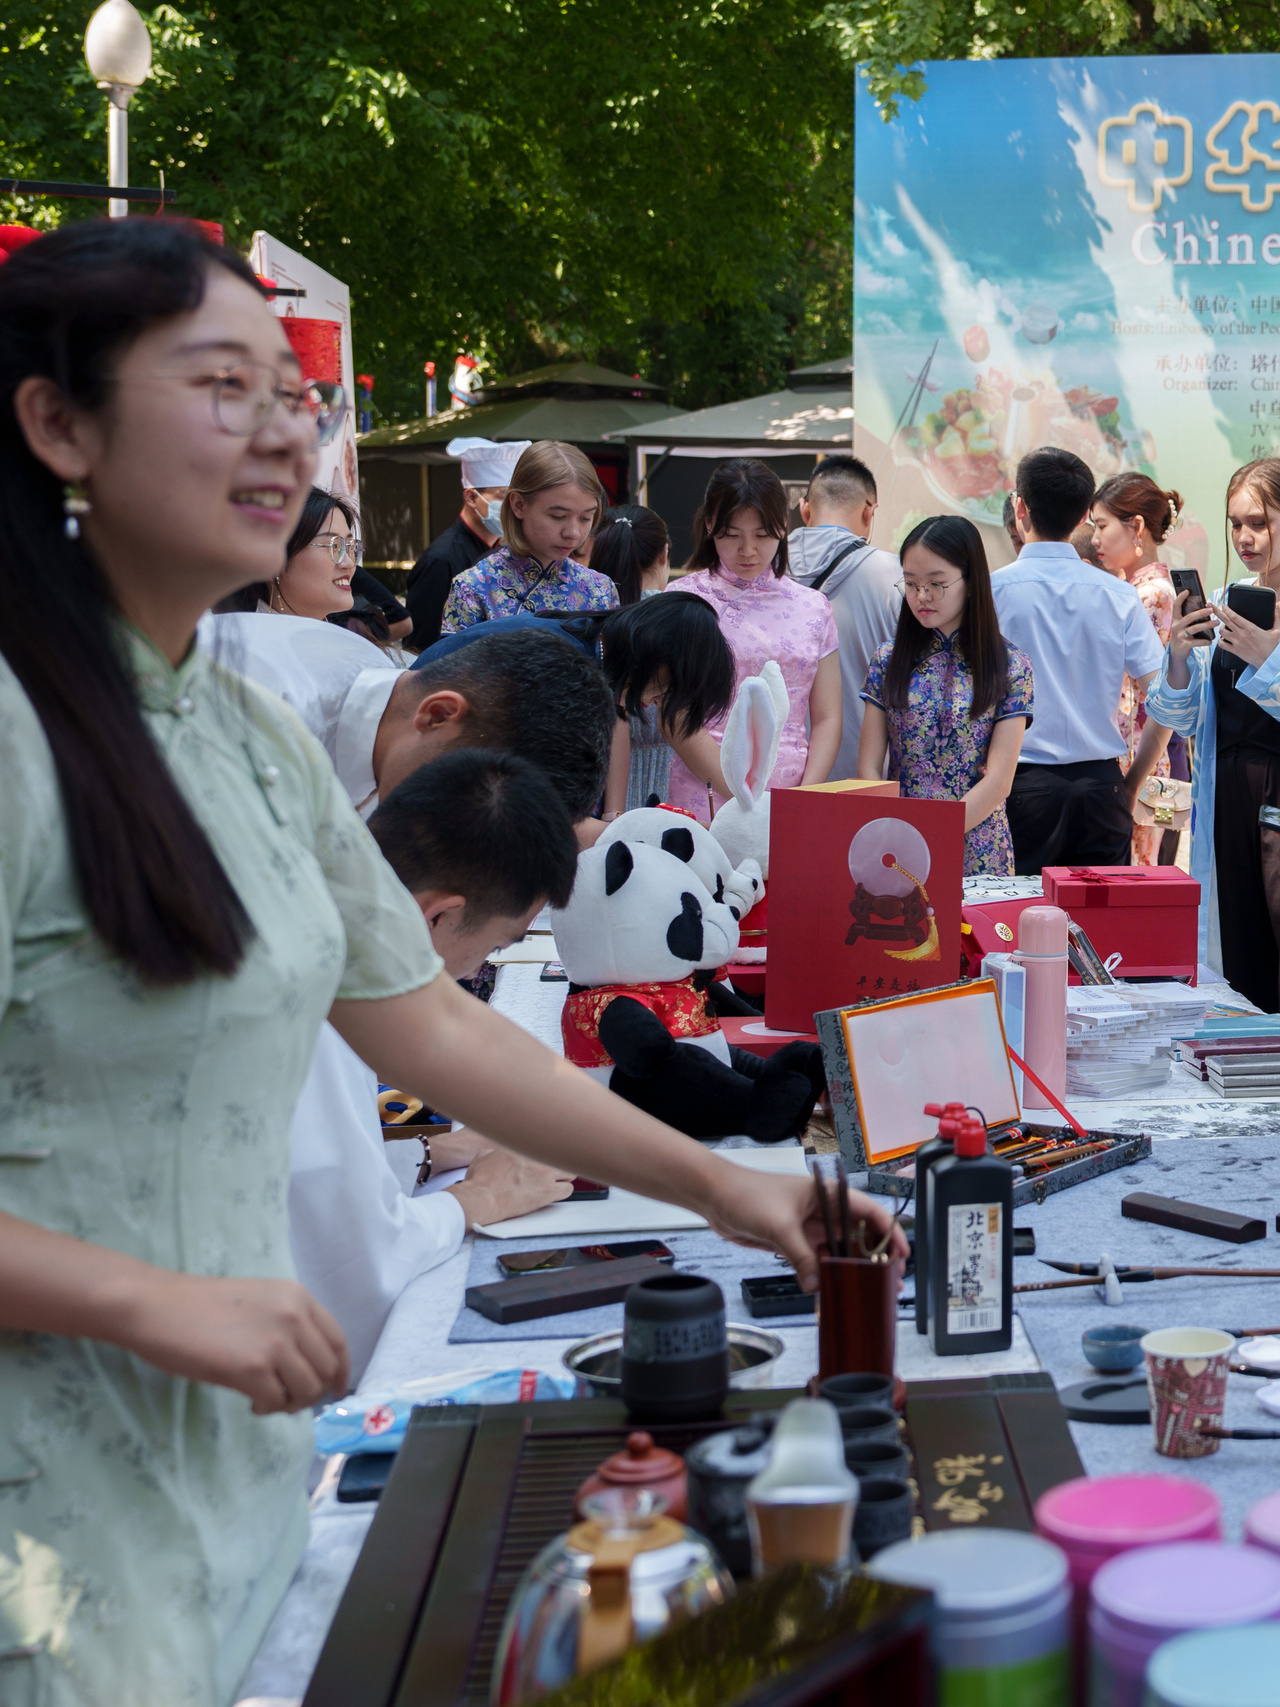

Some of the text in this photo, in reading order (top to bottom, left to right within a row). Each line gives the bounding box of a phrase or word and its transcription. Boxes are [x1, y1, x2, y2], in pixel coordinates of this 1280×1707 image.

[1111, 321, 1154, 335] Hosts:
[1159, 321, 1215, 337] Embassy
[1220, 321, 1234, 335] of
[1236, 321, 1256, 335] the
[1163, 377, 1238, 393] Organizer:
[1250, 424, 1269, 438] JV
